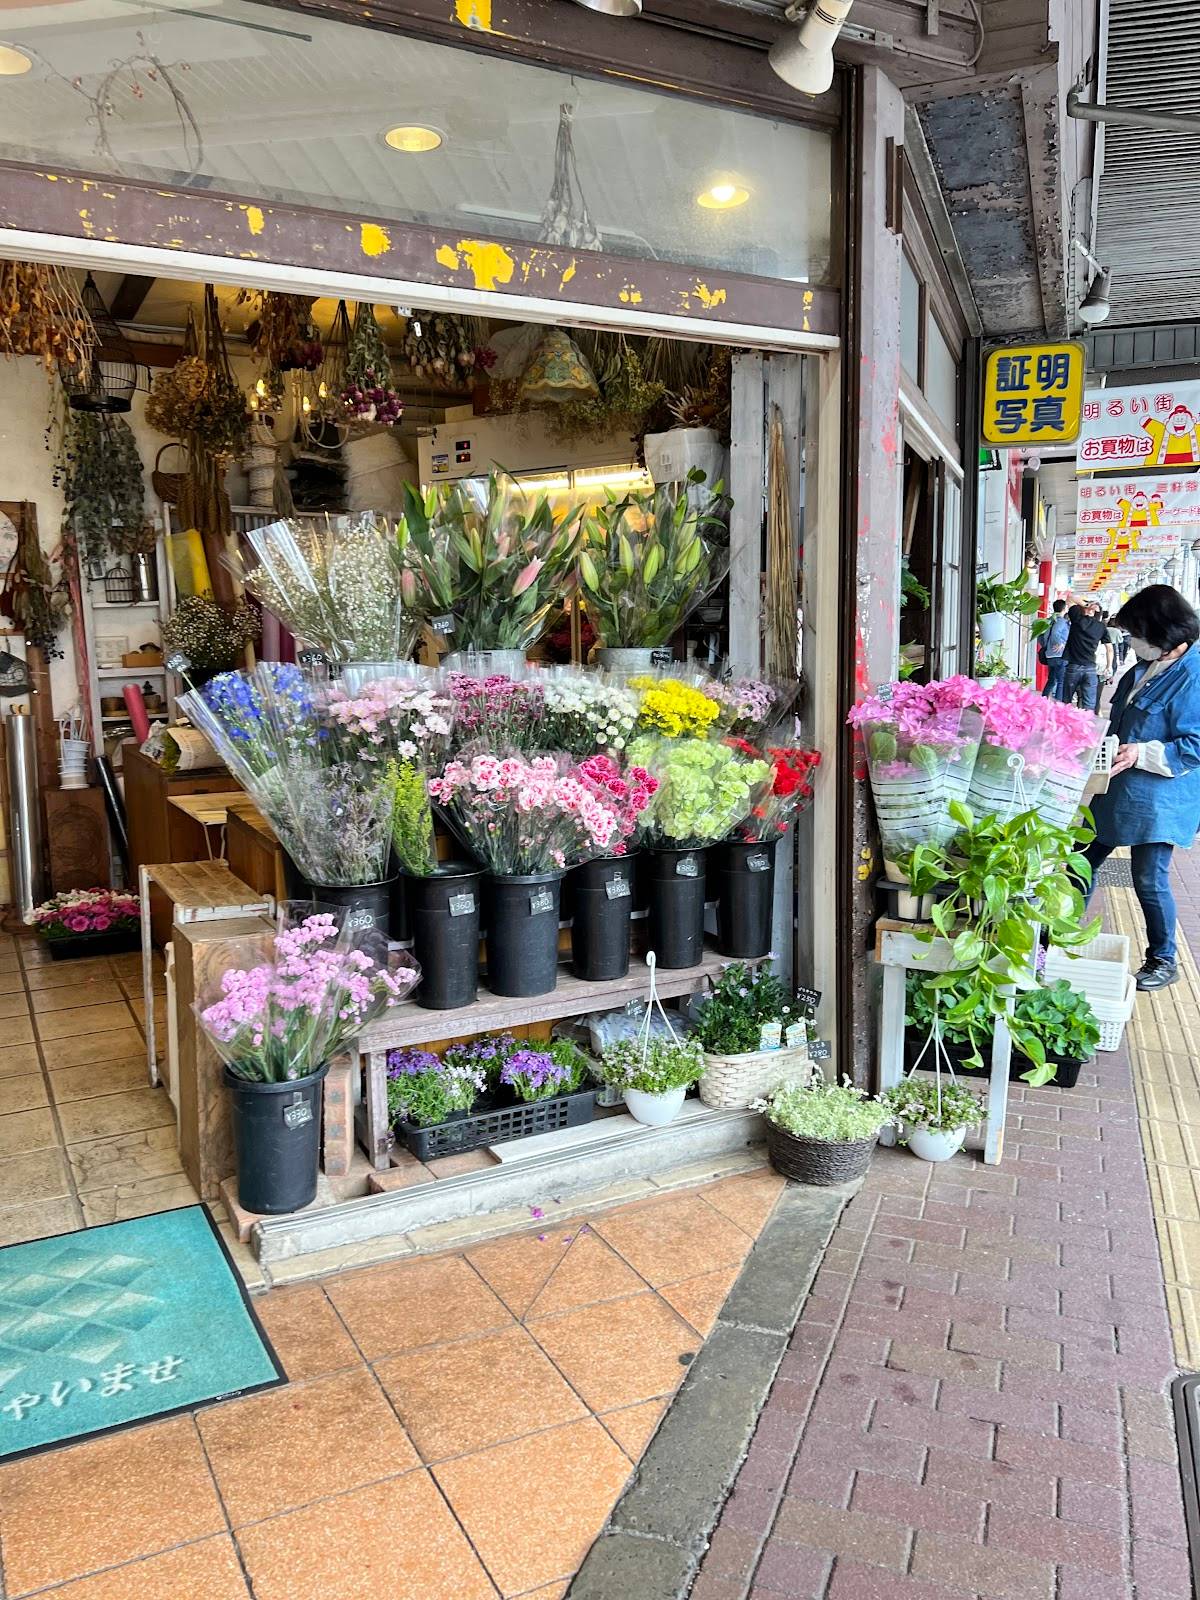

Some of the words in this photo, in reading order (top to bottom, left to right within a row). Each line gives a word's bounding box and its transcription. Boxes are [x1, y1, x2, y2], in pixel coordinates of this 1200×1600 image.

[996, 353, 1070, 391] 証明
[994, 396, 1066, 433] 写真
[1083, 394, 1173, 419] 明るい街
[1084, 437, 1150, 456] お買物は
[1081, 484, 1136, 498] 明るい街
[1081, 510, 1122, 520] お買物は
